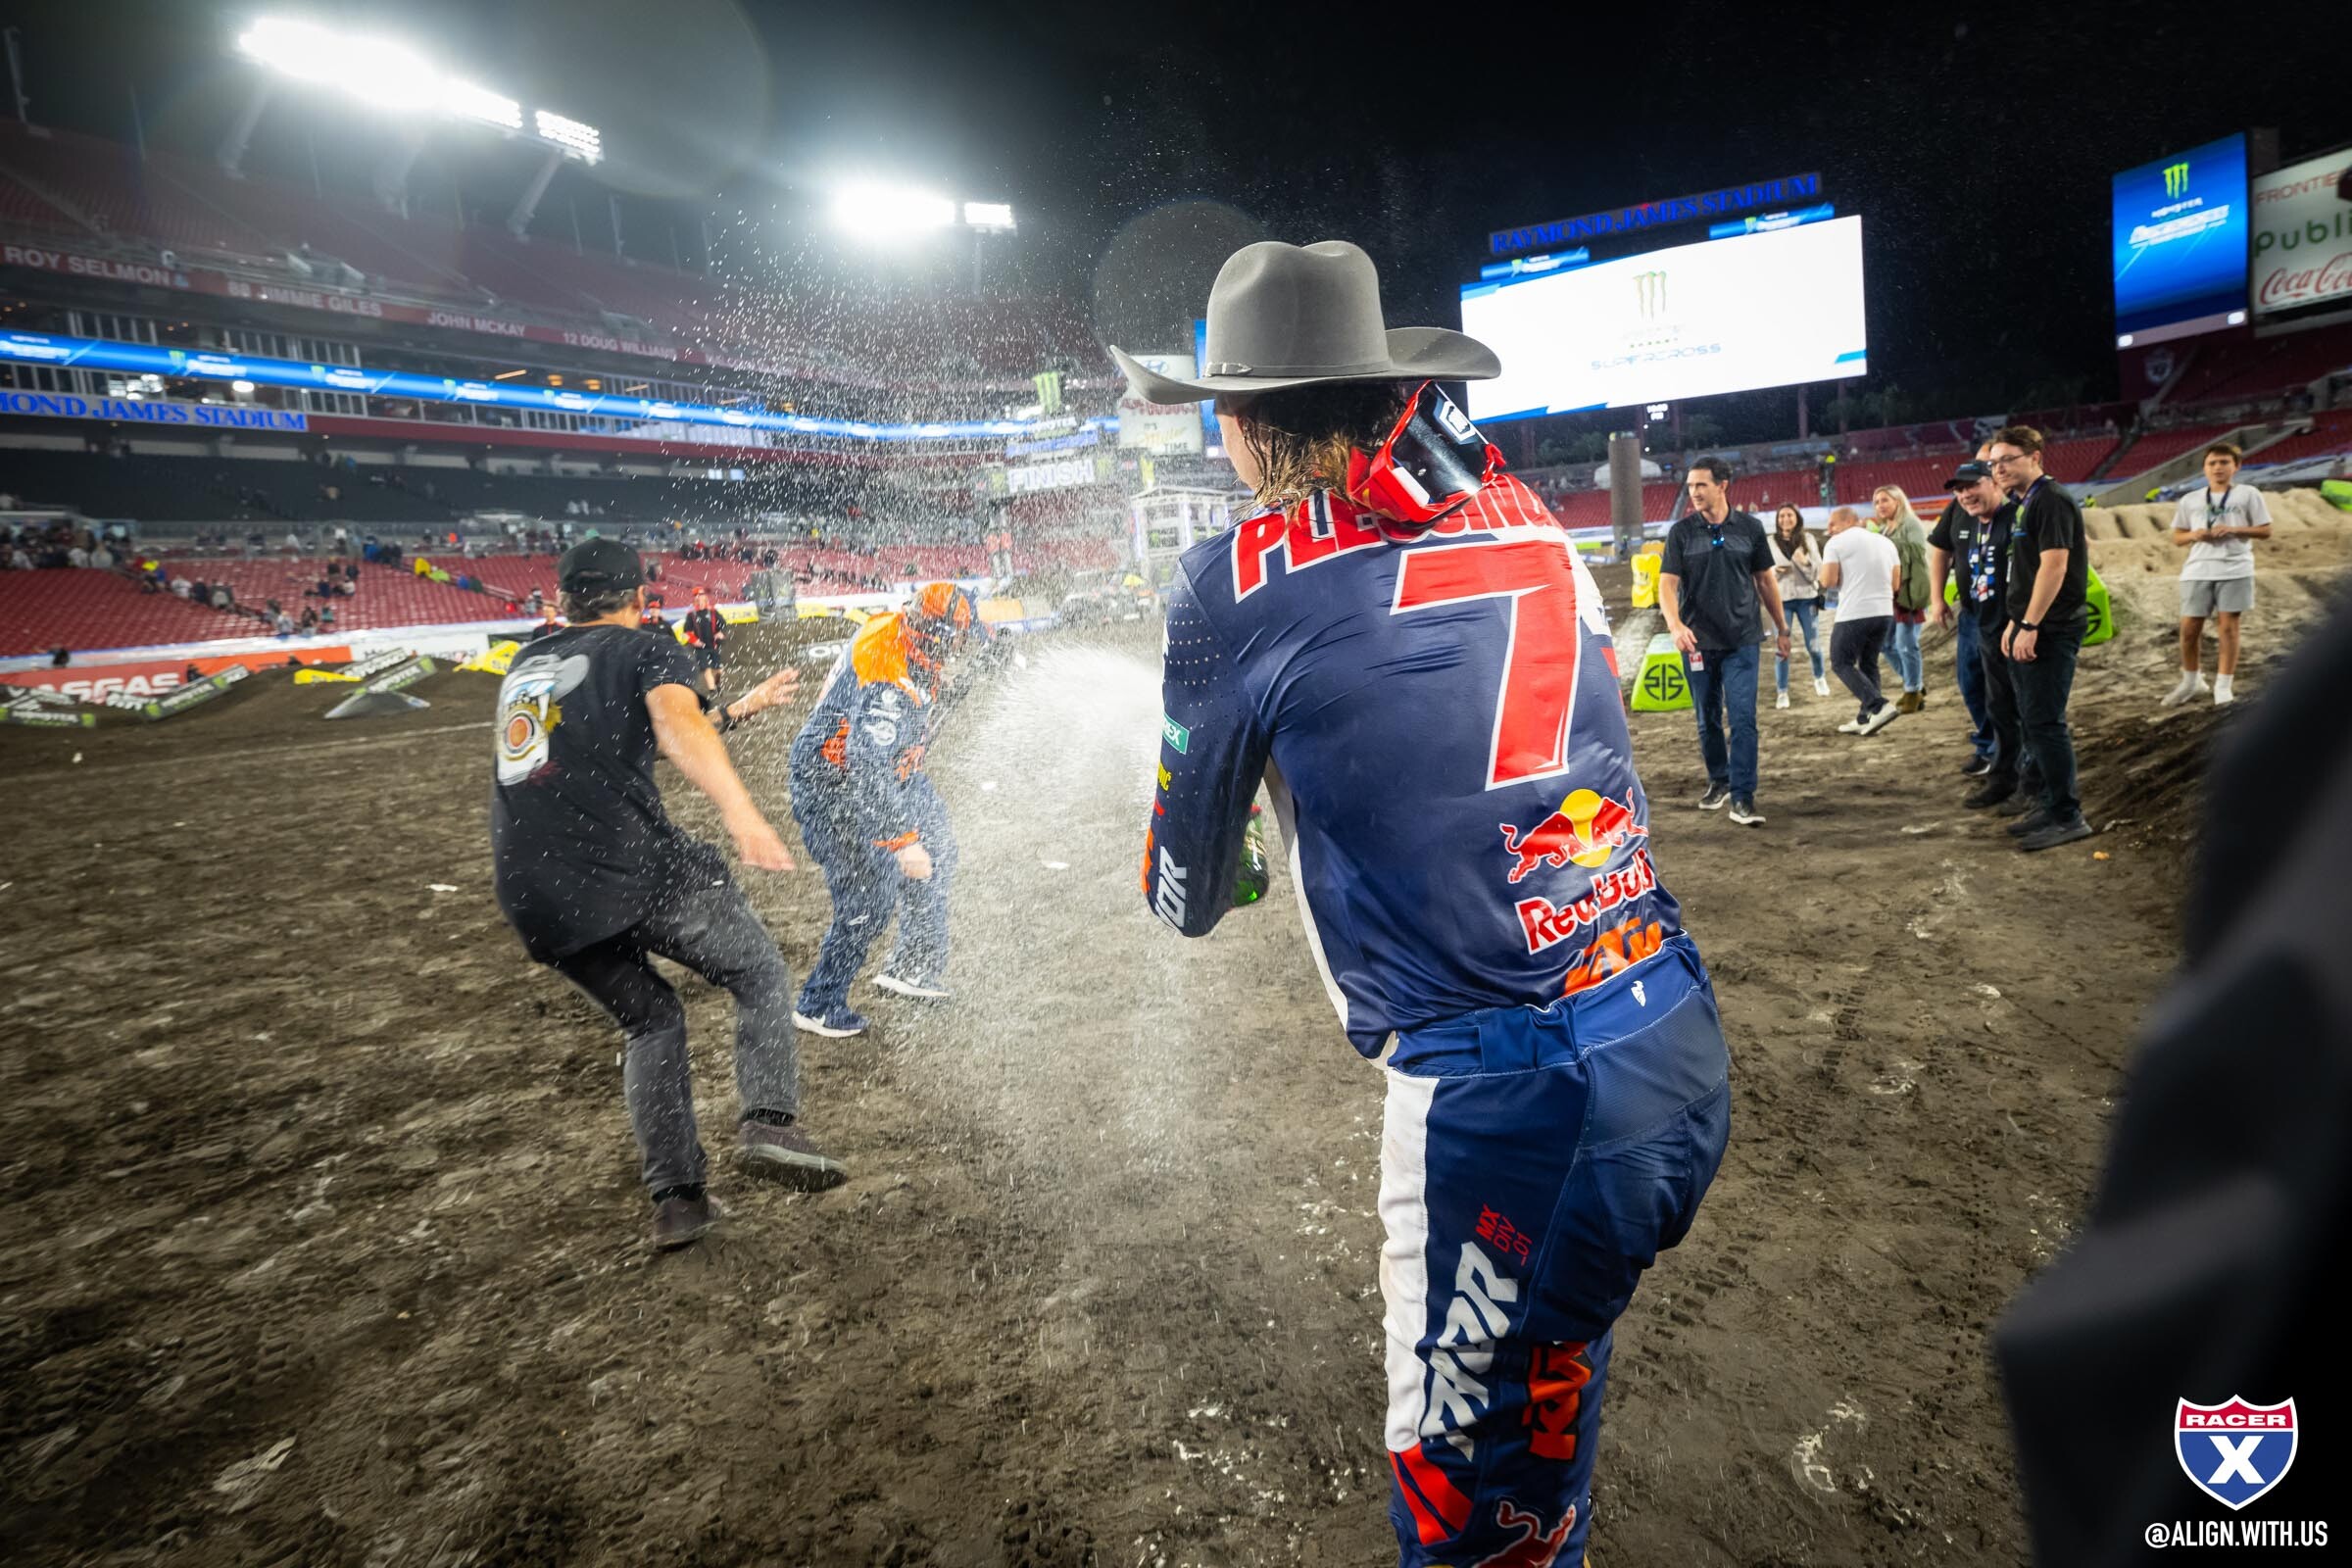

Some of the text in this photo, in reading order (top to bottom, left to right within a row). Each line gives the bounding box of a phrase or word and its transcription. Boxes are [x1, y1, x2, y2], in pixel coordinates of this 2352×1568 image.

[1493, 174, 1819, 253] RAYMOND JAMES STADIUM
[4, 246, 171, 285] ROY SELMON
[327, 295, 383, 317] GILES
[427, 311, 526, 337] JOHN MCKAY
[564, 331, 578, 346] 12
[580, 334, 618, 352] DOUG
[92, 400, 188, 422] JAMES
[196, 406, 306, 431] STADIUM
[1164, 442, 1189, 454] TIME
[1007, 458, 1096, 495] FINISH
[1390, 537, 1581, 793] 7
[1475, 1202, 1501, 1243] MX
[1493, 1215, 1516, 1253] DIV
